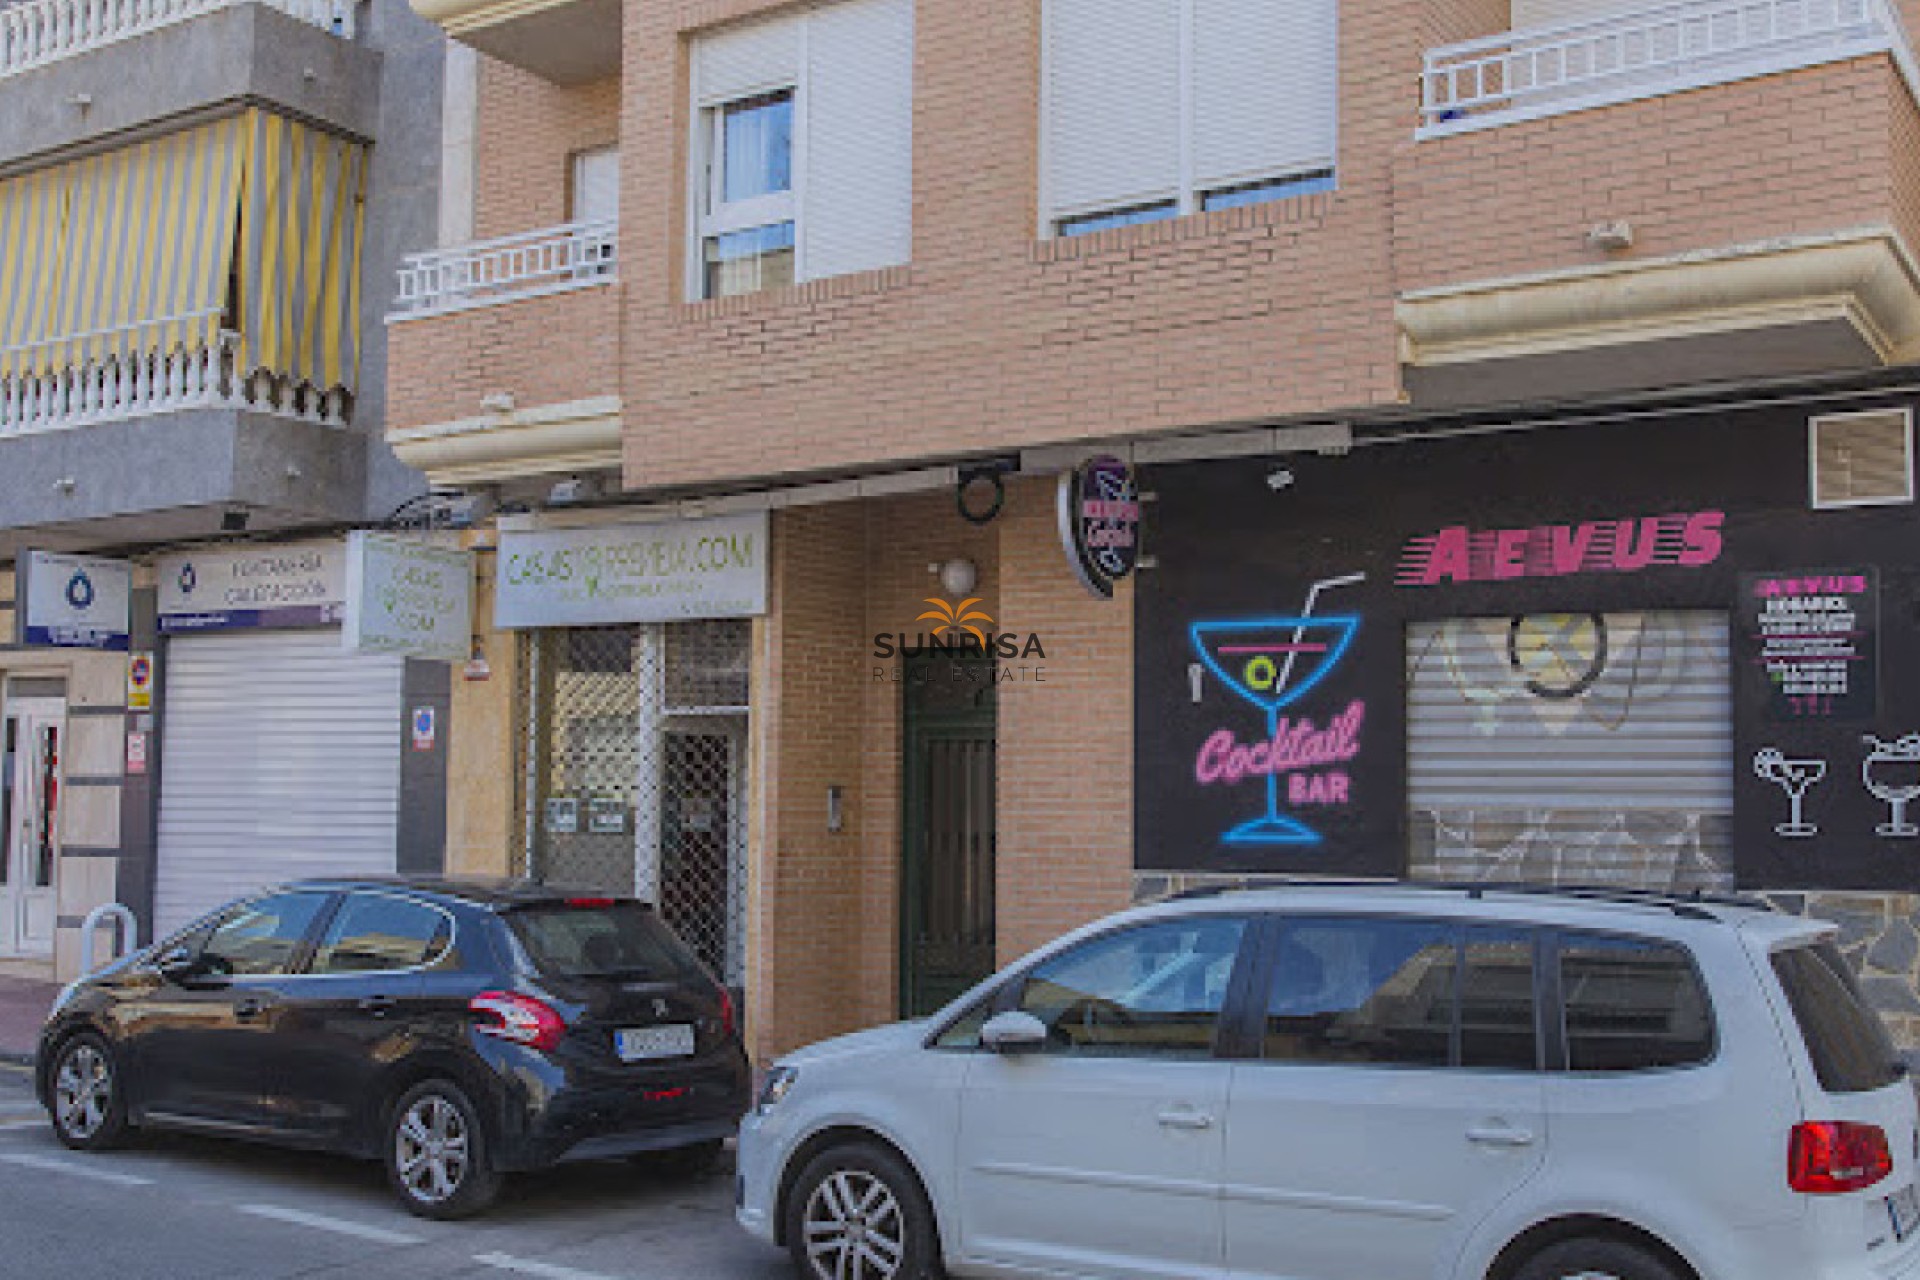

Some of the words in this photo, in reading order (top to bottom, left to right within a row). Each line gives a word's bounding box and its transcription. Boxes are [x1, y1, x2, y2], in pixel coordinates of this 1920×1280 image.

[1398, 511, 1726, 585] AEVUS
[1196, 699, 1365, 784] Cocktail
[1288, 772, 1350, 804] BAR
